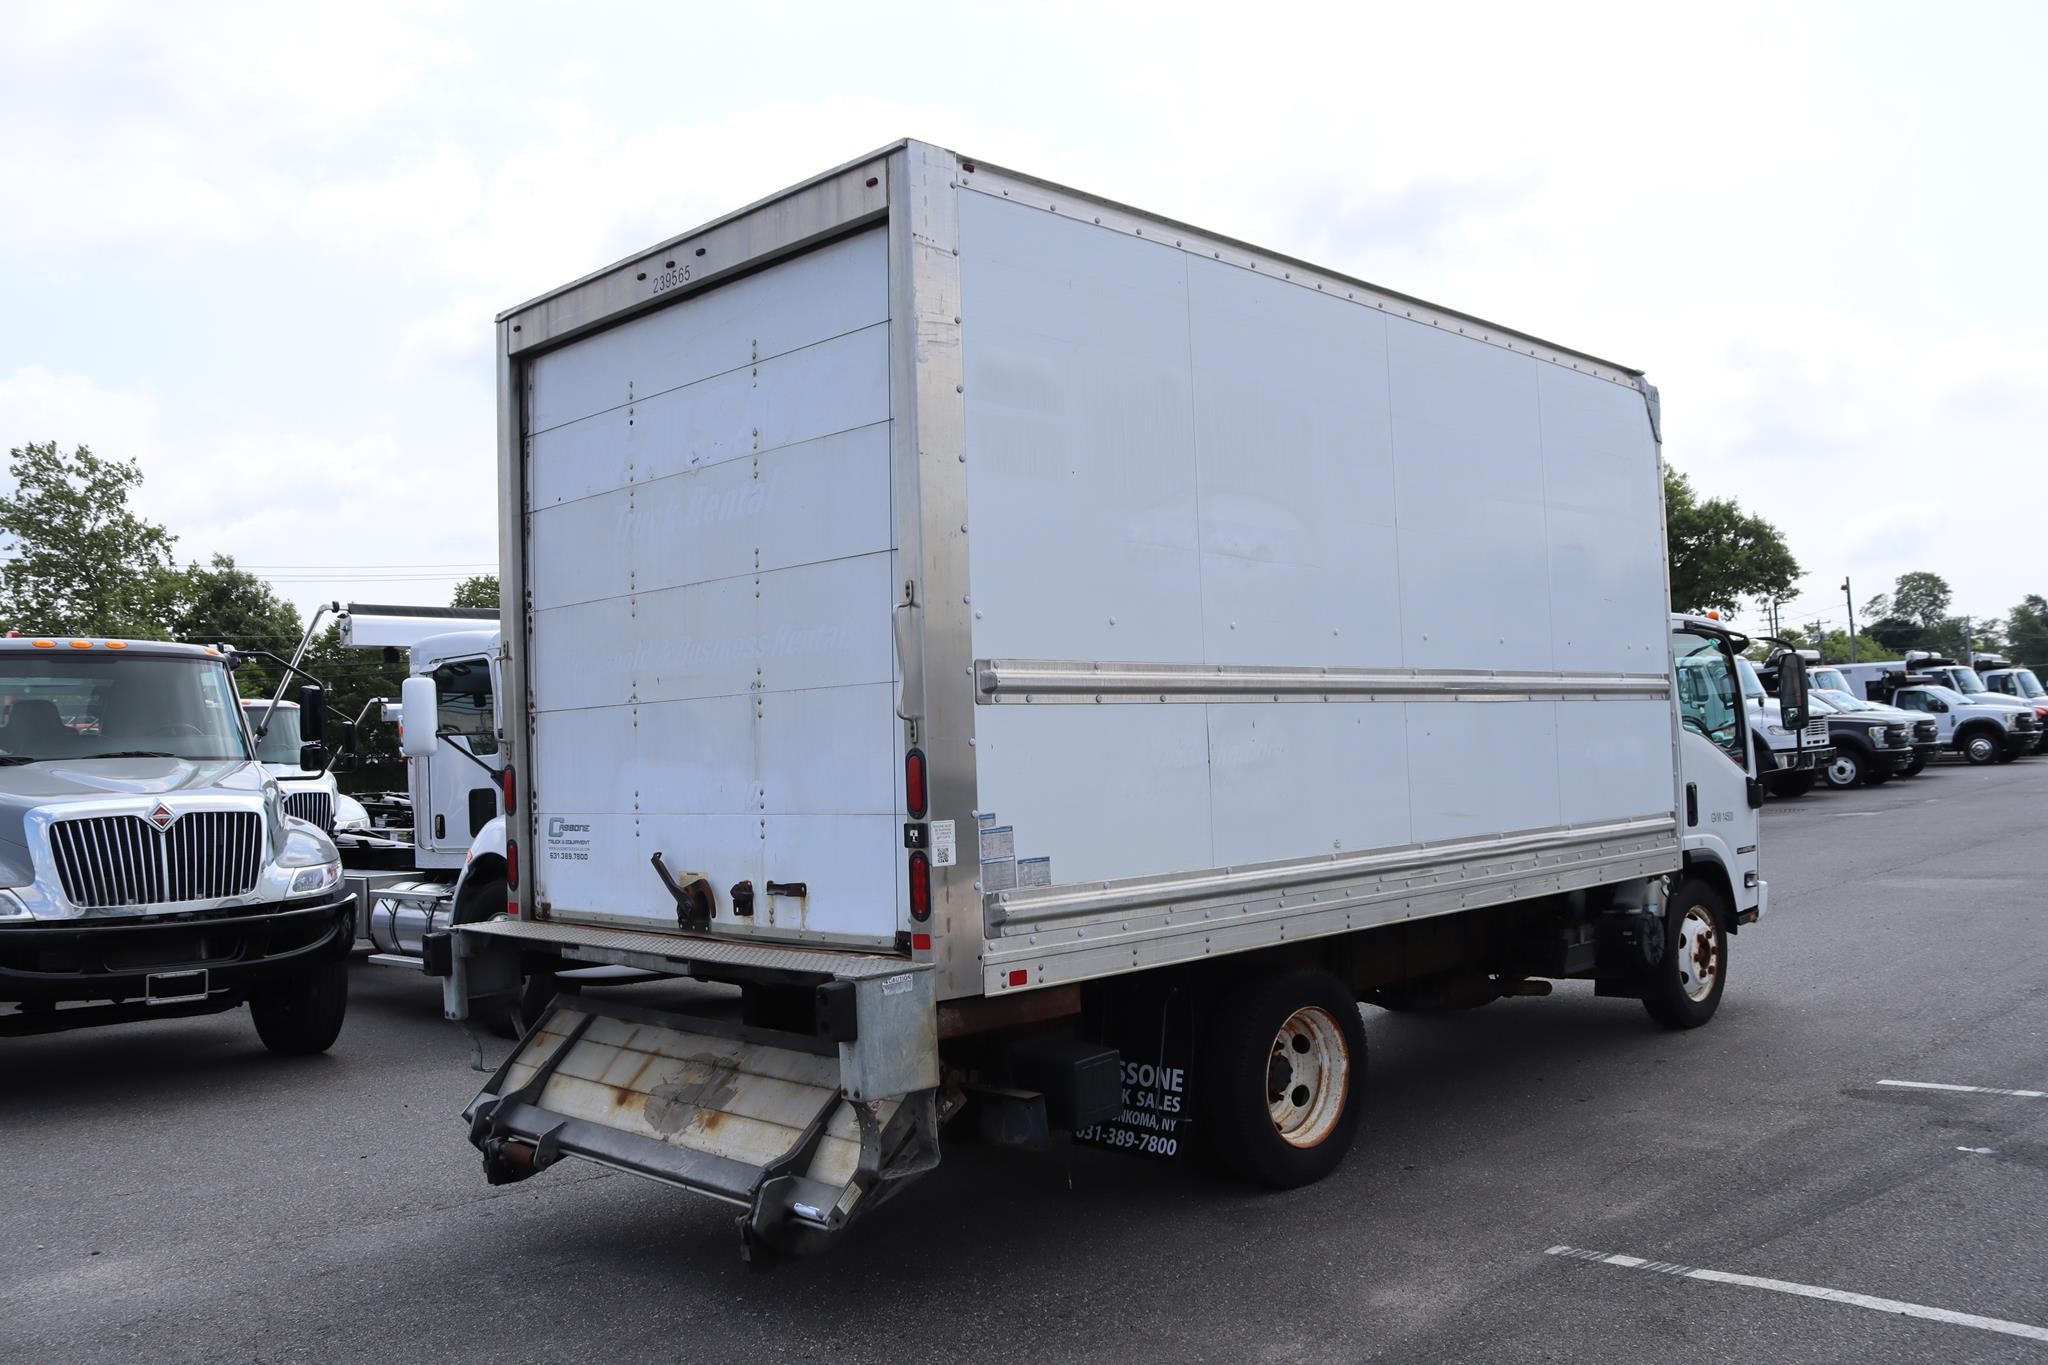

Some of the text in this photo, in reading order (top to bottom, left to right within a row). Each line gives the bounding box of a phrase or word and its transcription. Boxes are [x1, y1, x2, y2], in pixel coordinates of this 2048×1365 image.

[653, 265, 691, 293] 239565
[1136, 1091, 1181, 1112] SALES
[1161, 1118, 1177, 1132] NY
